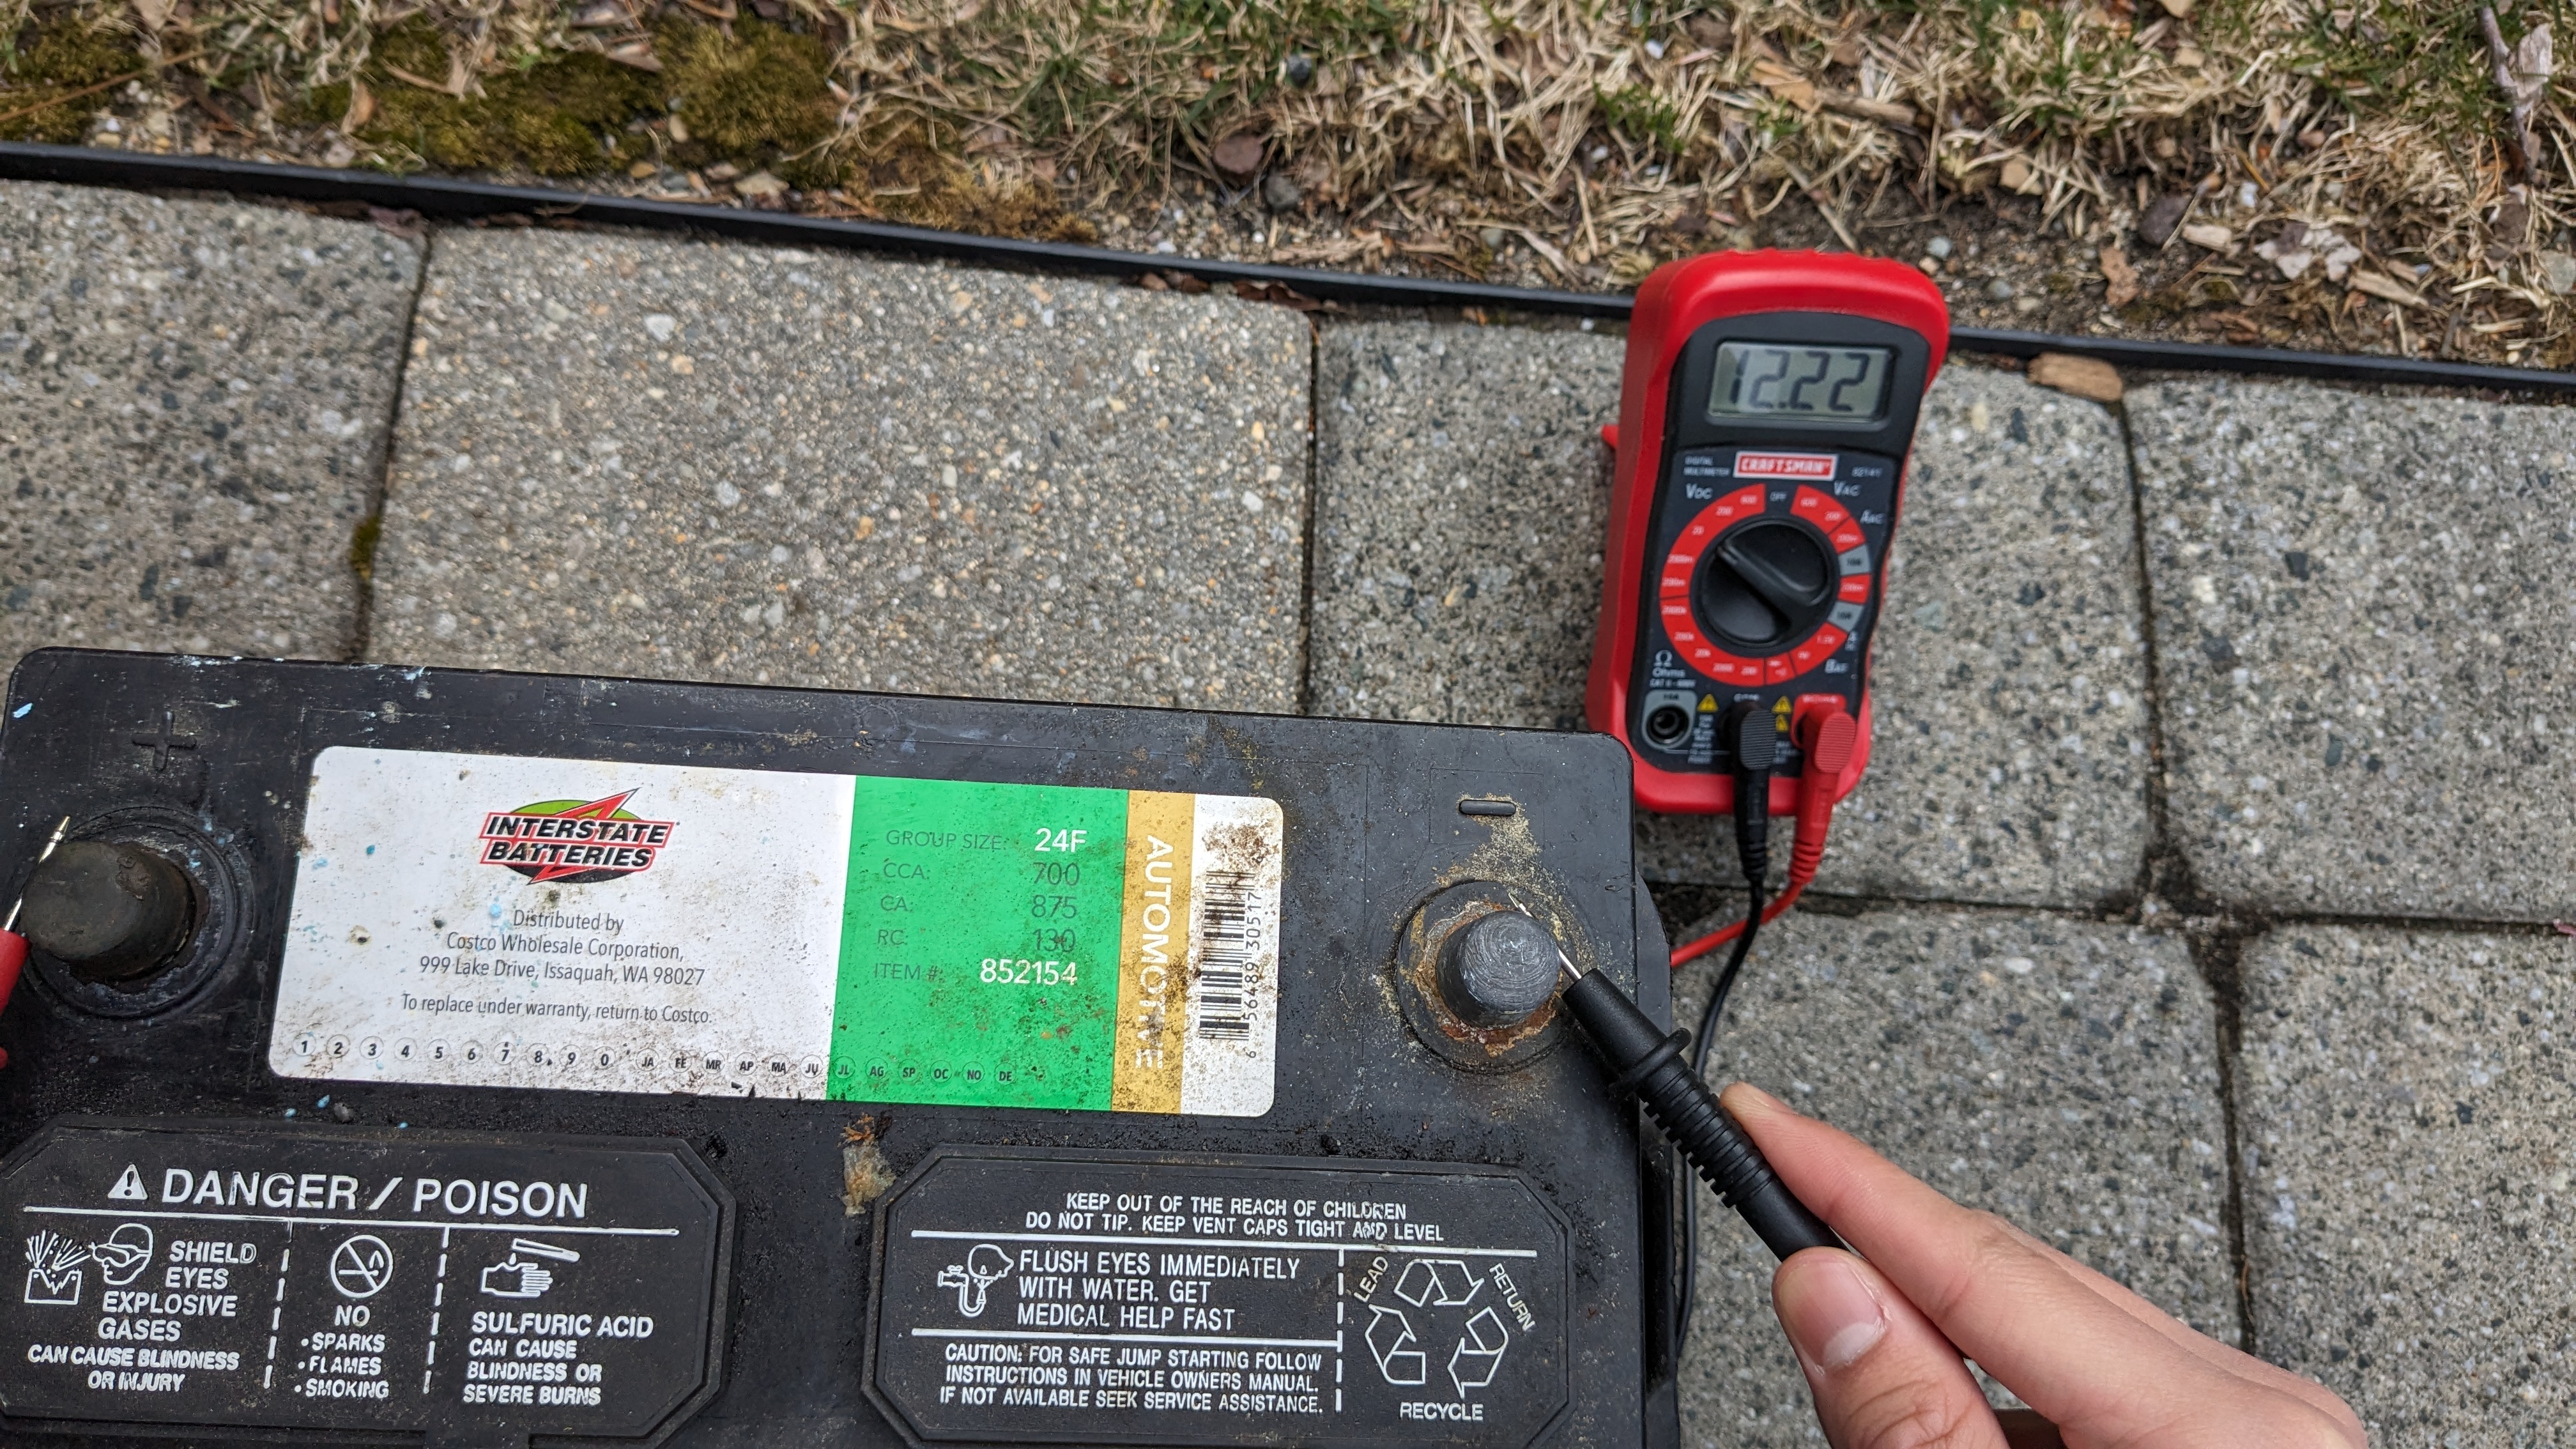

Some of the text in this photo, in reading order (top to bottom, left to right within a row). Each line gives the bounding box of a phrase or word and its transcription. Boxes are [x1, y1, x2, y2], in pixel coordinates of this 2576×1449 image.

[1729, 349, 1869, 411] 12.22
[1741, 456, 1825, 473] CRAFTSMAN
[486, 816, 670, 843] INTERSTATE
[886, 829, 957, 848] GROUP
[1034, 827, 1087, 853] 24F
[487, 841, 653, 867] BATTERIES
[1032, 862, 1080, 886] 700
[1031, 894, 1078, 919] 875
[513, 908, 625, 936] Distributed by
[1245, 891, 1262, 951] 30517
[447, 931, 684, 962] Costco Wholesale Corporation,
[1032, 928, 1077, 953] 130
[1135, 834, 1174, 1070] AUTOMOTIVE
[420, 956, 705, 986] 999 Lake Drive, Issaquah, WA 98027
[873, 962, 921, 980] ITEM
[979, 958, 1078, 986] 852154
[1243, 961, 1261, 1022] 56489
[402, 993, 713, 1024] To replace under warranty, return to Costco.
[301, 1040, 1013, 1082] 1 2 3 4 5 6 7 8 9 0 JA FE MR AP MA JU JL AG SP OC NO DE
[1245, 1049, 1257, 1059] 6
[162, 1168, 588, 1218] DANGER / POISON
[1066, 1192, 1407, 1220] KEEP OUT OF THE REACH OF CHILDREN
[1025, 1211, 1445, 1242] DO NOT TIP. KEEP VENT CAPS TIGHT AND LEVEL
[169, 1240, 257, 1264] SHIELD
[1019, 1249, 1301, 1280] FLUSH EYES IMMEDIATELY
[165, 1266, 229, 1290] EYES
[1019, 1276, 1211, 1304] WITH WATER. GET
[1353, 1255, 1389, 1303] LEAD
[102, 1291, 238, 1317] EXPLOSIVE
[1489, 1262, 1536, 1331] RETURN
[98, 1317, 182, 1342] GASES
[334, 1305, 371, 1327] NO
[471, 1311, 654, 1338] SULFURIC ACID
[1017, 1302, 1236, 1331] MEDICAL HELP FAST
[312, 1332, 385, 1353] SPARKS
[469, 1338, 578, 1359] CAN CAUSE
[27, 1344, 240, 1370] CAN CAUSE BLINDNESS
[309, 1356, 381, 1376] FLAMES
[945, 1343, 1322, 1371] CAUTION: FOR SAFE JUMP STARTING FOLLOW
[88, 1370, 185, 1392] OR INJURY
[467, 1360, 602, 1383] BLINDNESS OR
[946, 1364, 1319, 1392] INSTRUCTIONS IN VEHICLE OWNERS MANUAL.
[305, 1378, 390, 1399] SMOKING
[463, 1383, 601, 1405] SEVERE BURNS
[940, 1386, 1323, 1414] IF NOT AVAILABLE SEEK SERVICE ASSISTANCE.
[1399, 1402, 1483, 1421] RECYCLE
